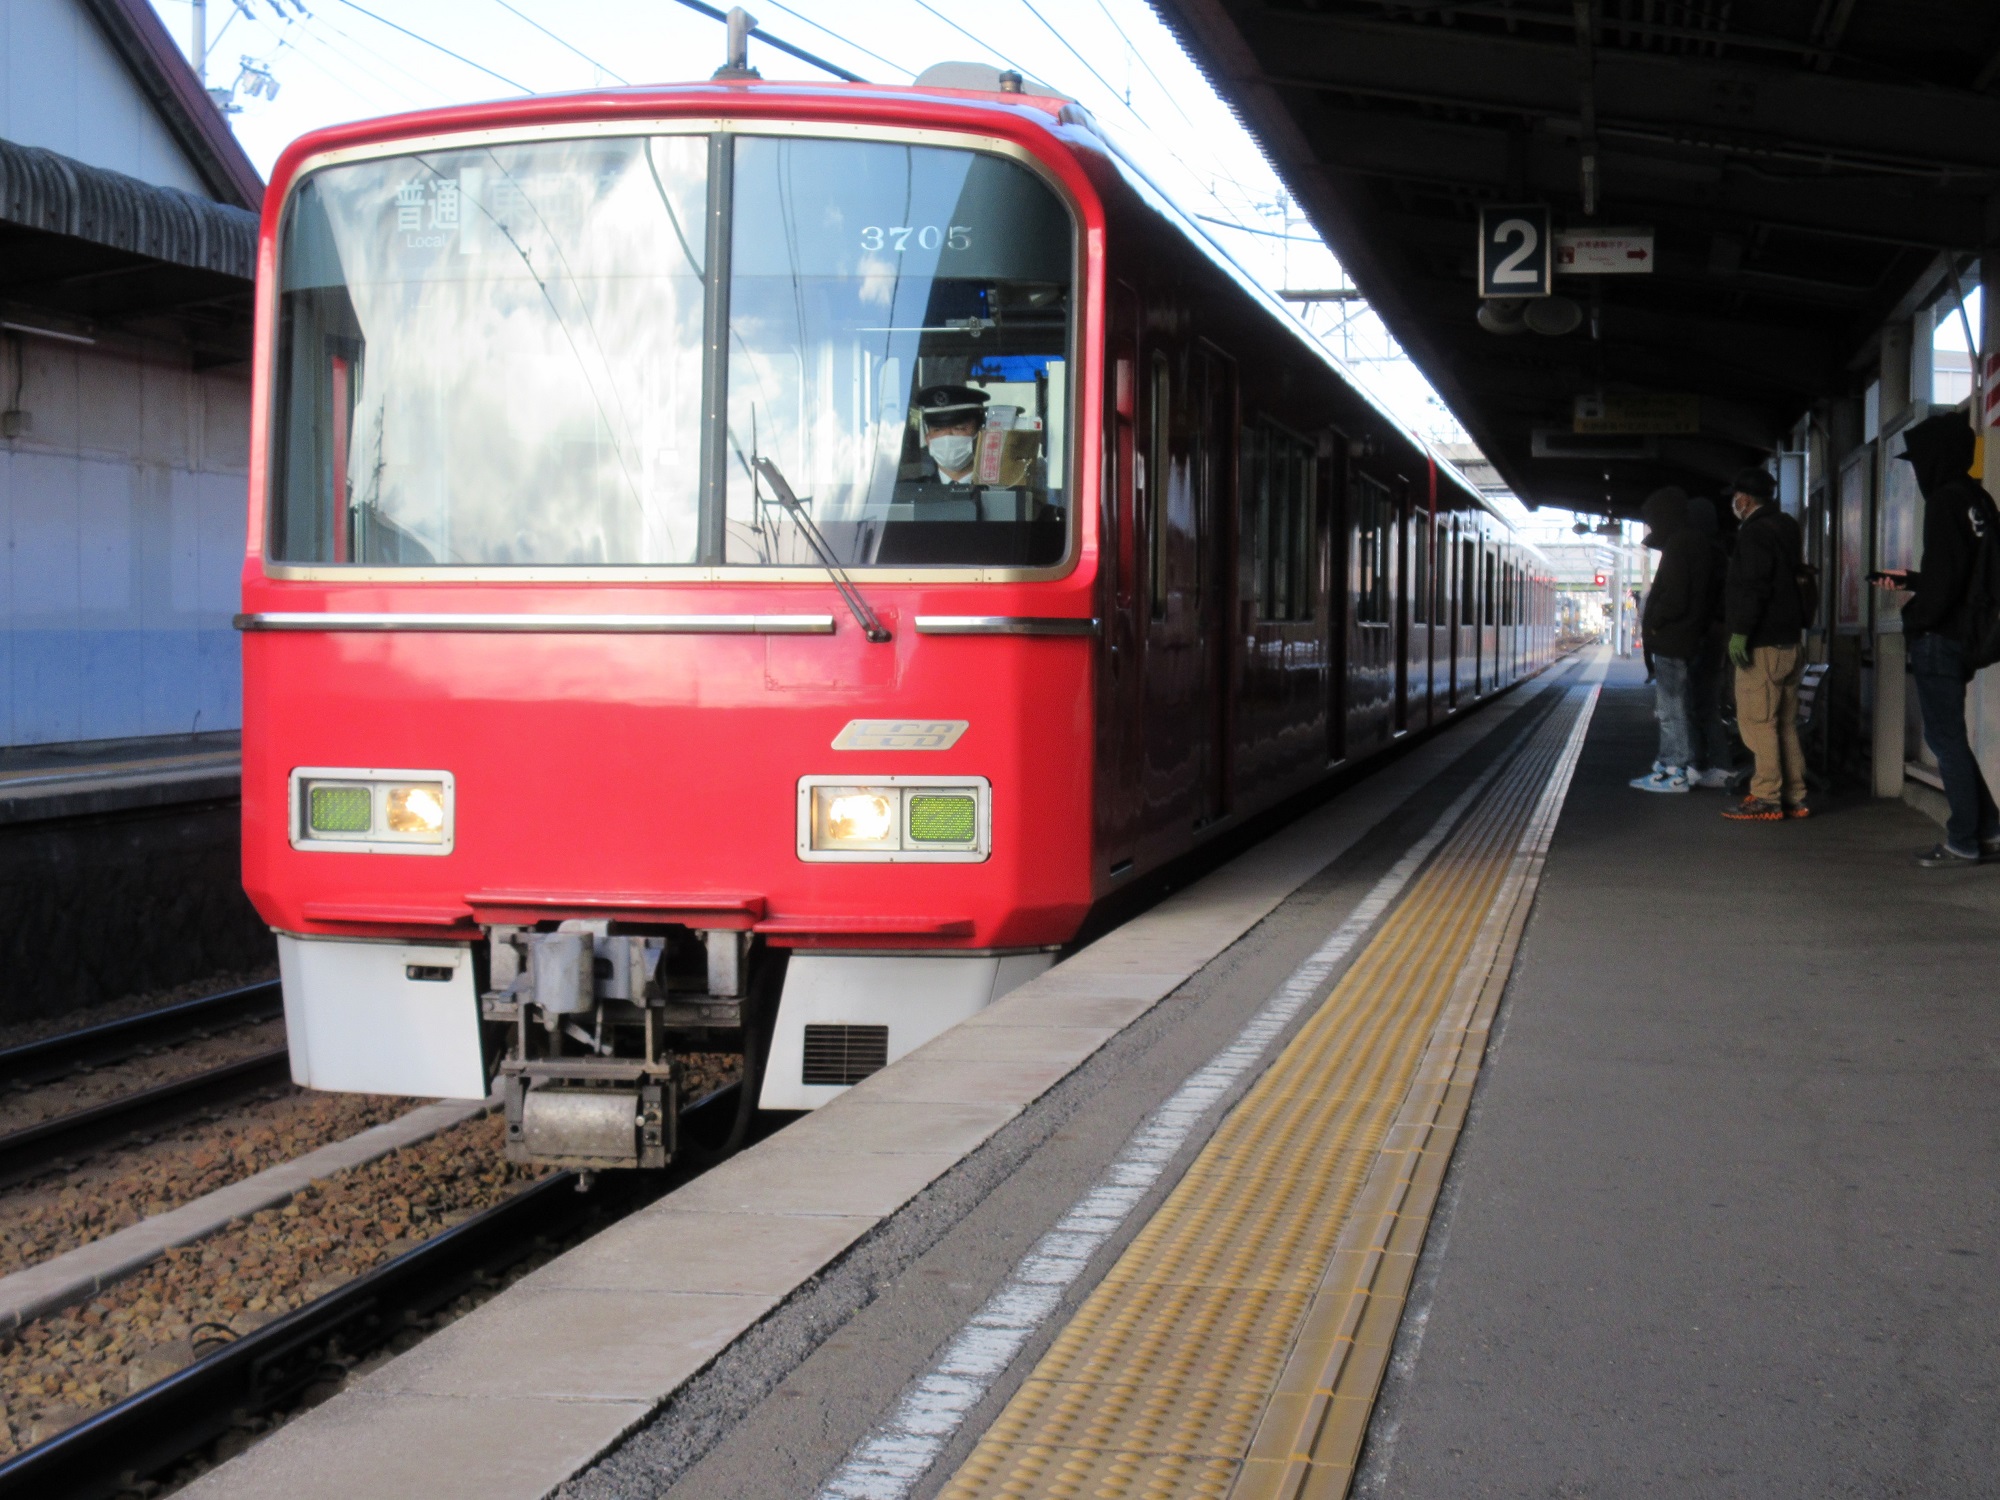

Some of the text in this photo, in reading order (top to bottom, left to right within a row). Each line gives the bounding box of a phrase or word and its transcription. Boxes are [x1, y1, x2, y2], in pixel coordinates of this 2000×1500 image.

[395, 179, 460, 232] 普通
[406, 233, 446, 248] Local
[860, 225, 973, 251] 3705
[1492, 218, 1539, 284] 2
